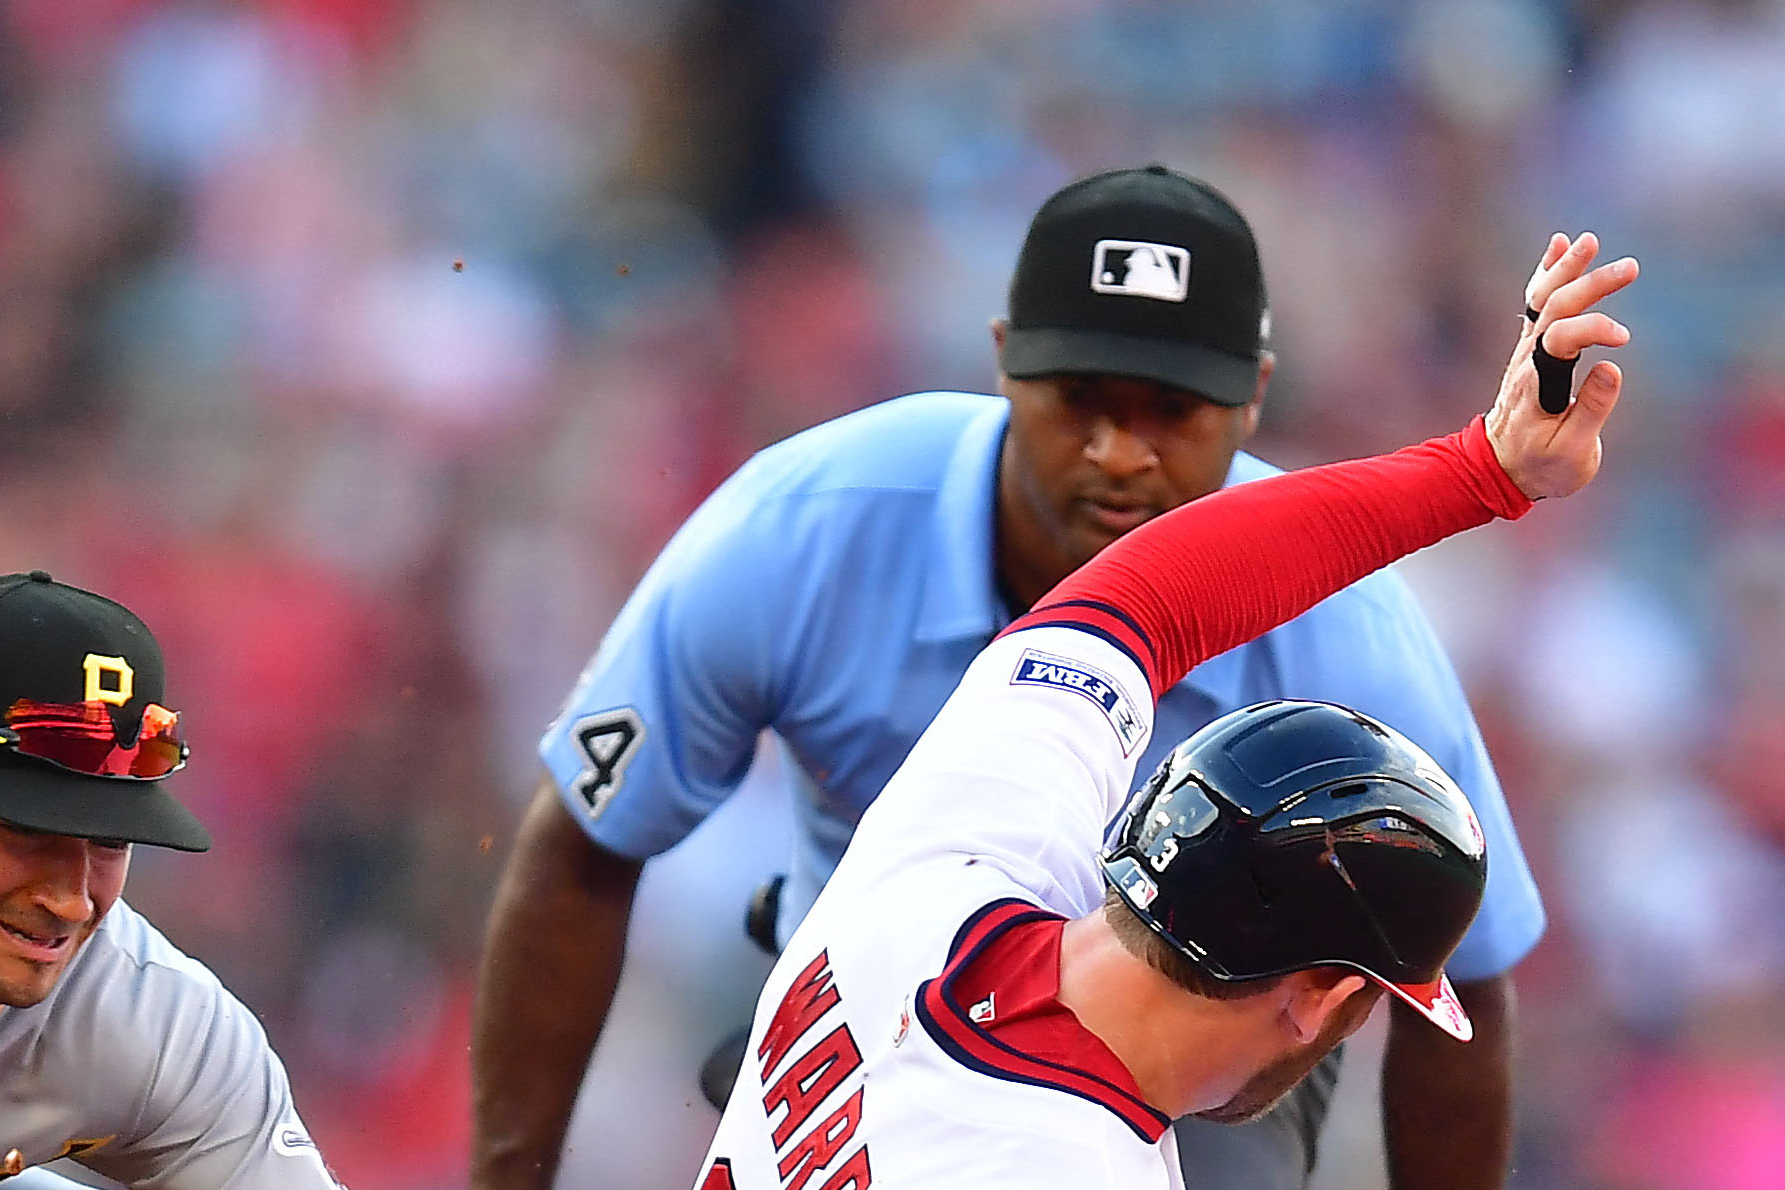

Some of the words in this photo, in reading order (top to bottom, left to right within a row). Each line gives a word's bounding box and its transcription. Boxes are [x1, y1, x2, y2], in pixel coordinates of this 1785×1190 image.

[83, 652, 135, 708] P
[1025, 661, 1113, 703] FBM
[576, 718, 639, 810] 4
[1150, 837, 1179, 873] 3
